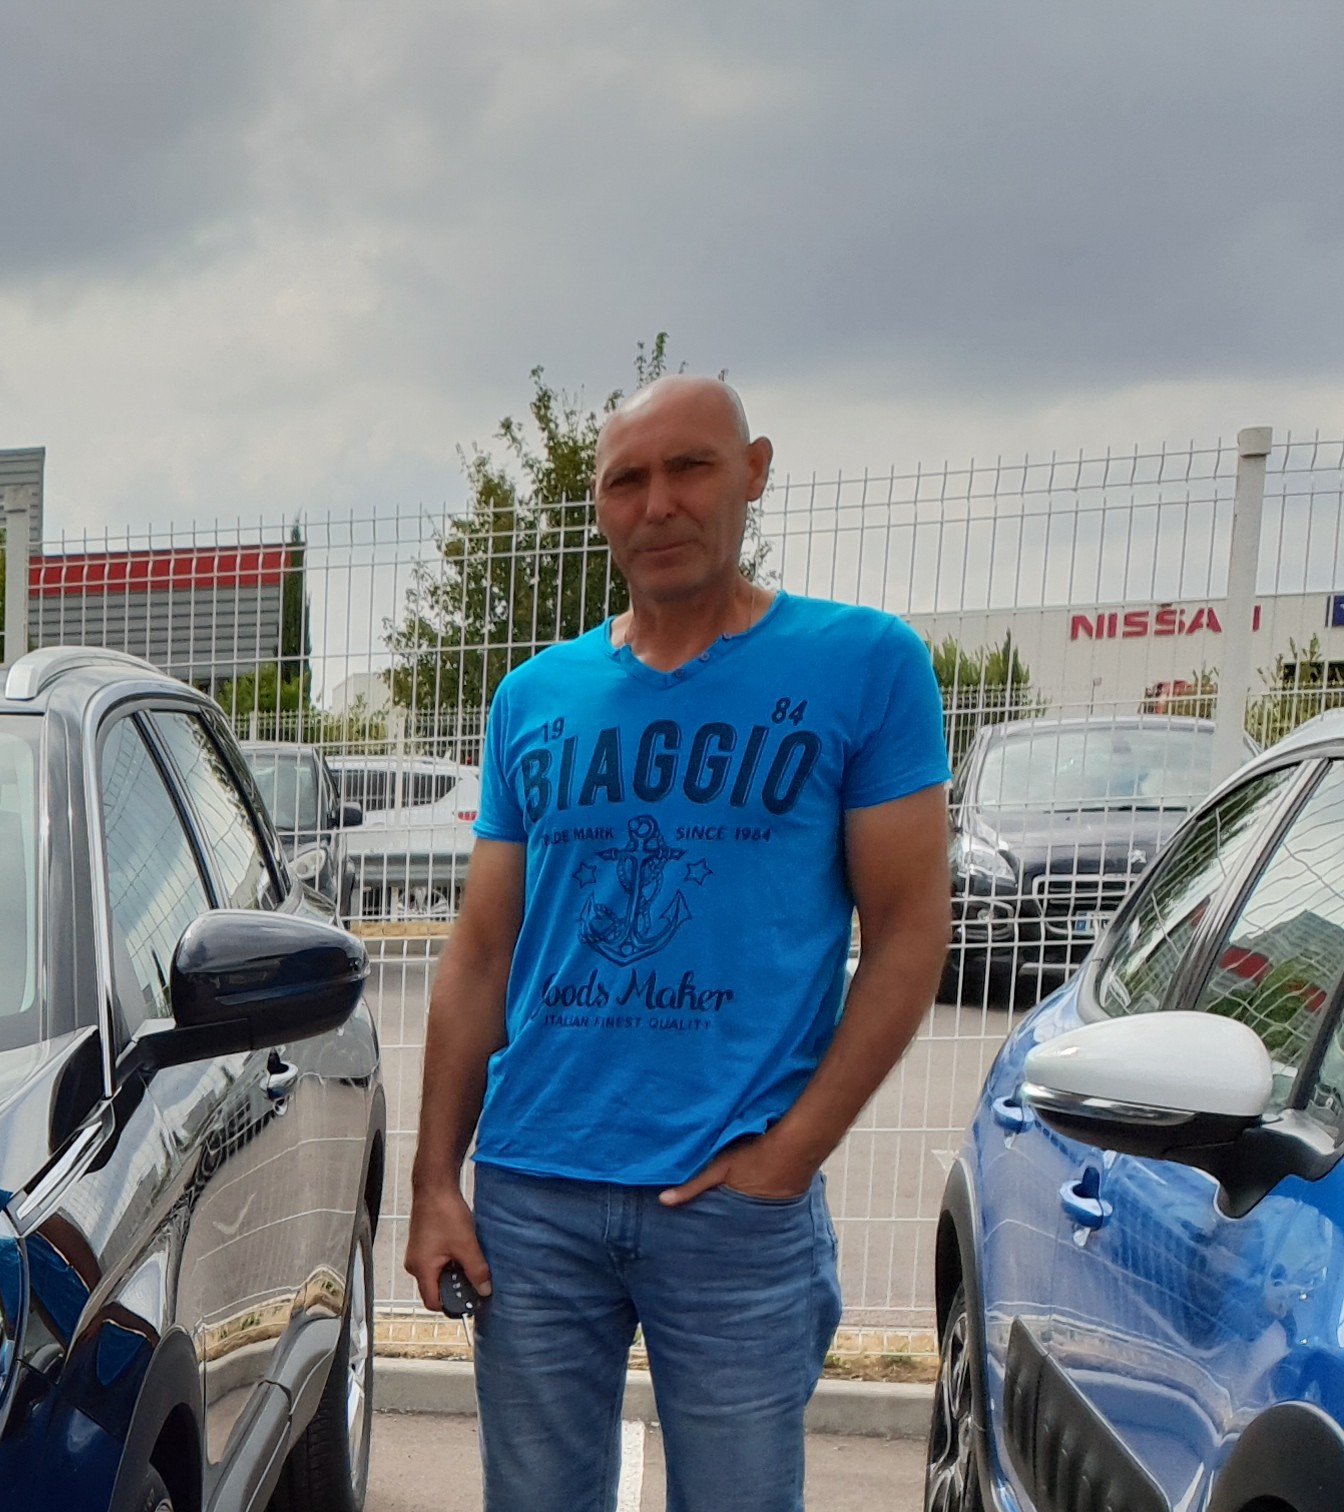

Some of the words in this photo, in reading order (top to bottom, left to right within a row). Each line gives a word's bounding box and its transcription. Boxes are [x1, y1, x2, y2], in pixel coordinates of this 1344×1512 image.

[771, 697, 808, 726] 84
[542, 716, 565, 743] 19
[520, 719, 823, 824] BIAGGIO
[675, 825, 725, 842] SINCE
[615, 967, 734, 1012] Maker
